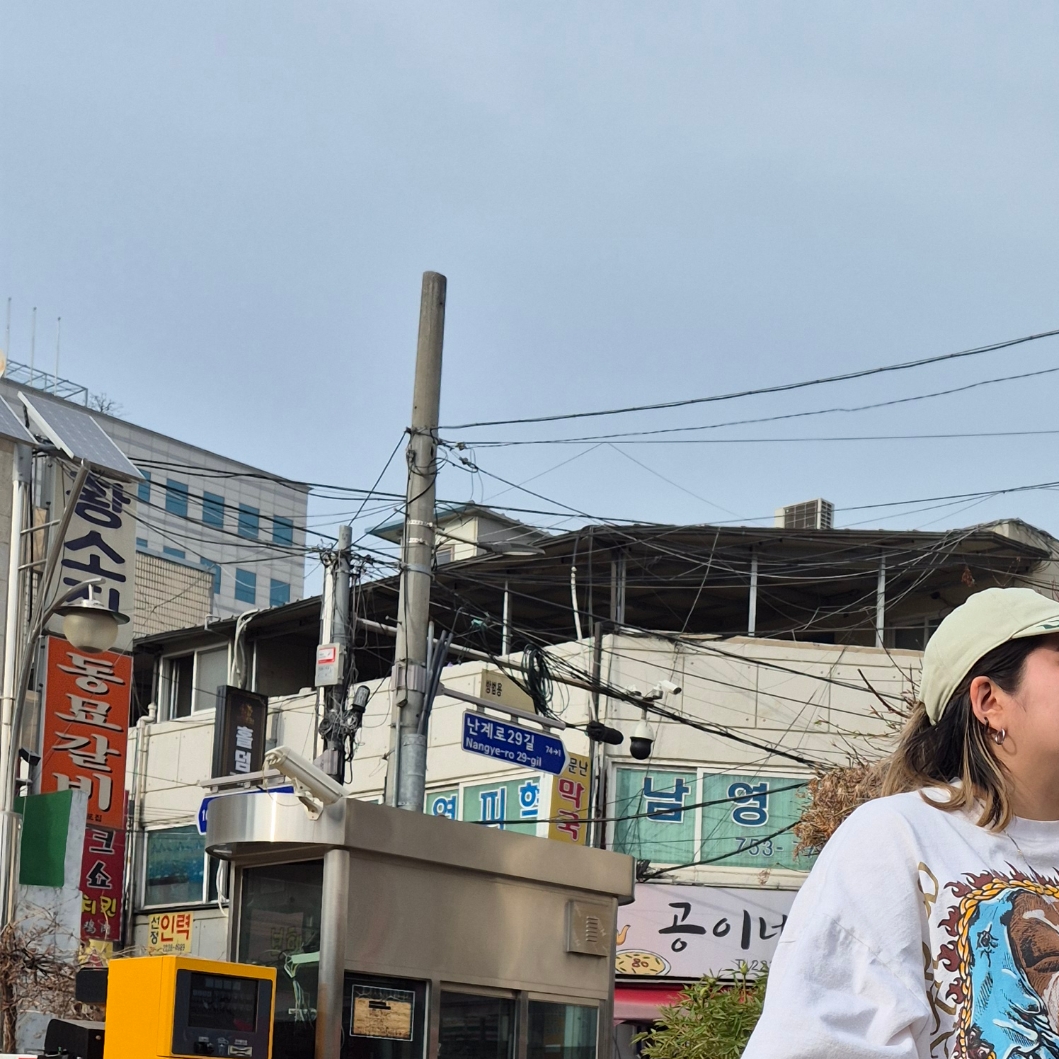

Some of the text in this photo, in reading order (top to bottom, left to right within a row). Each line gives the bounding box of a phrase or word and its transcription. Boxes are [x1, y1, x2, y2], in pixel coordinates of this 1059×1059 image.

[486, 680, 502, 697] 방범용
[467, 717, 535, 752] 난계로29길
[466, 737, 515, 760] Nangye-ro
[516, 752, 542, 767] 29-gil
[160, 914, 191, 942] 인력
